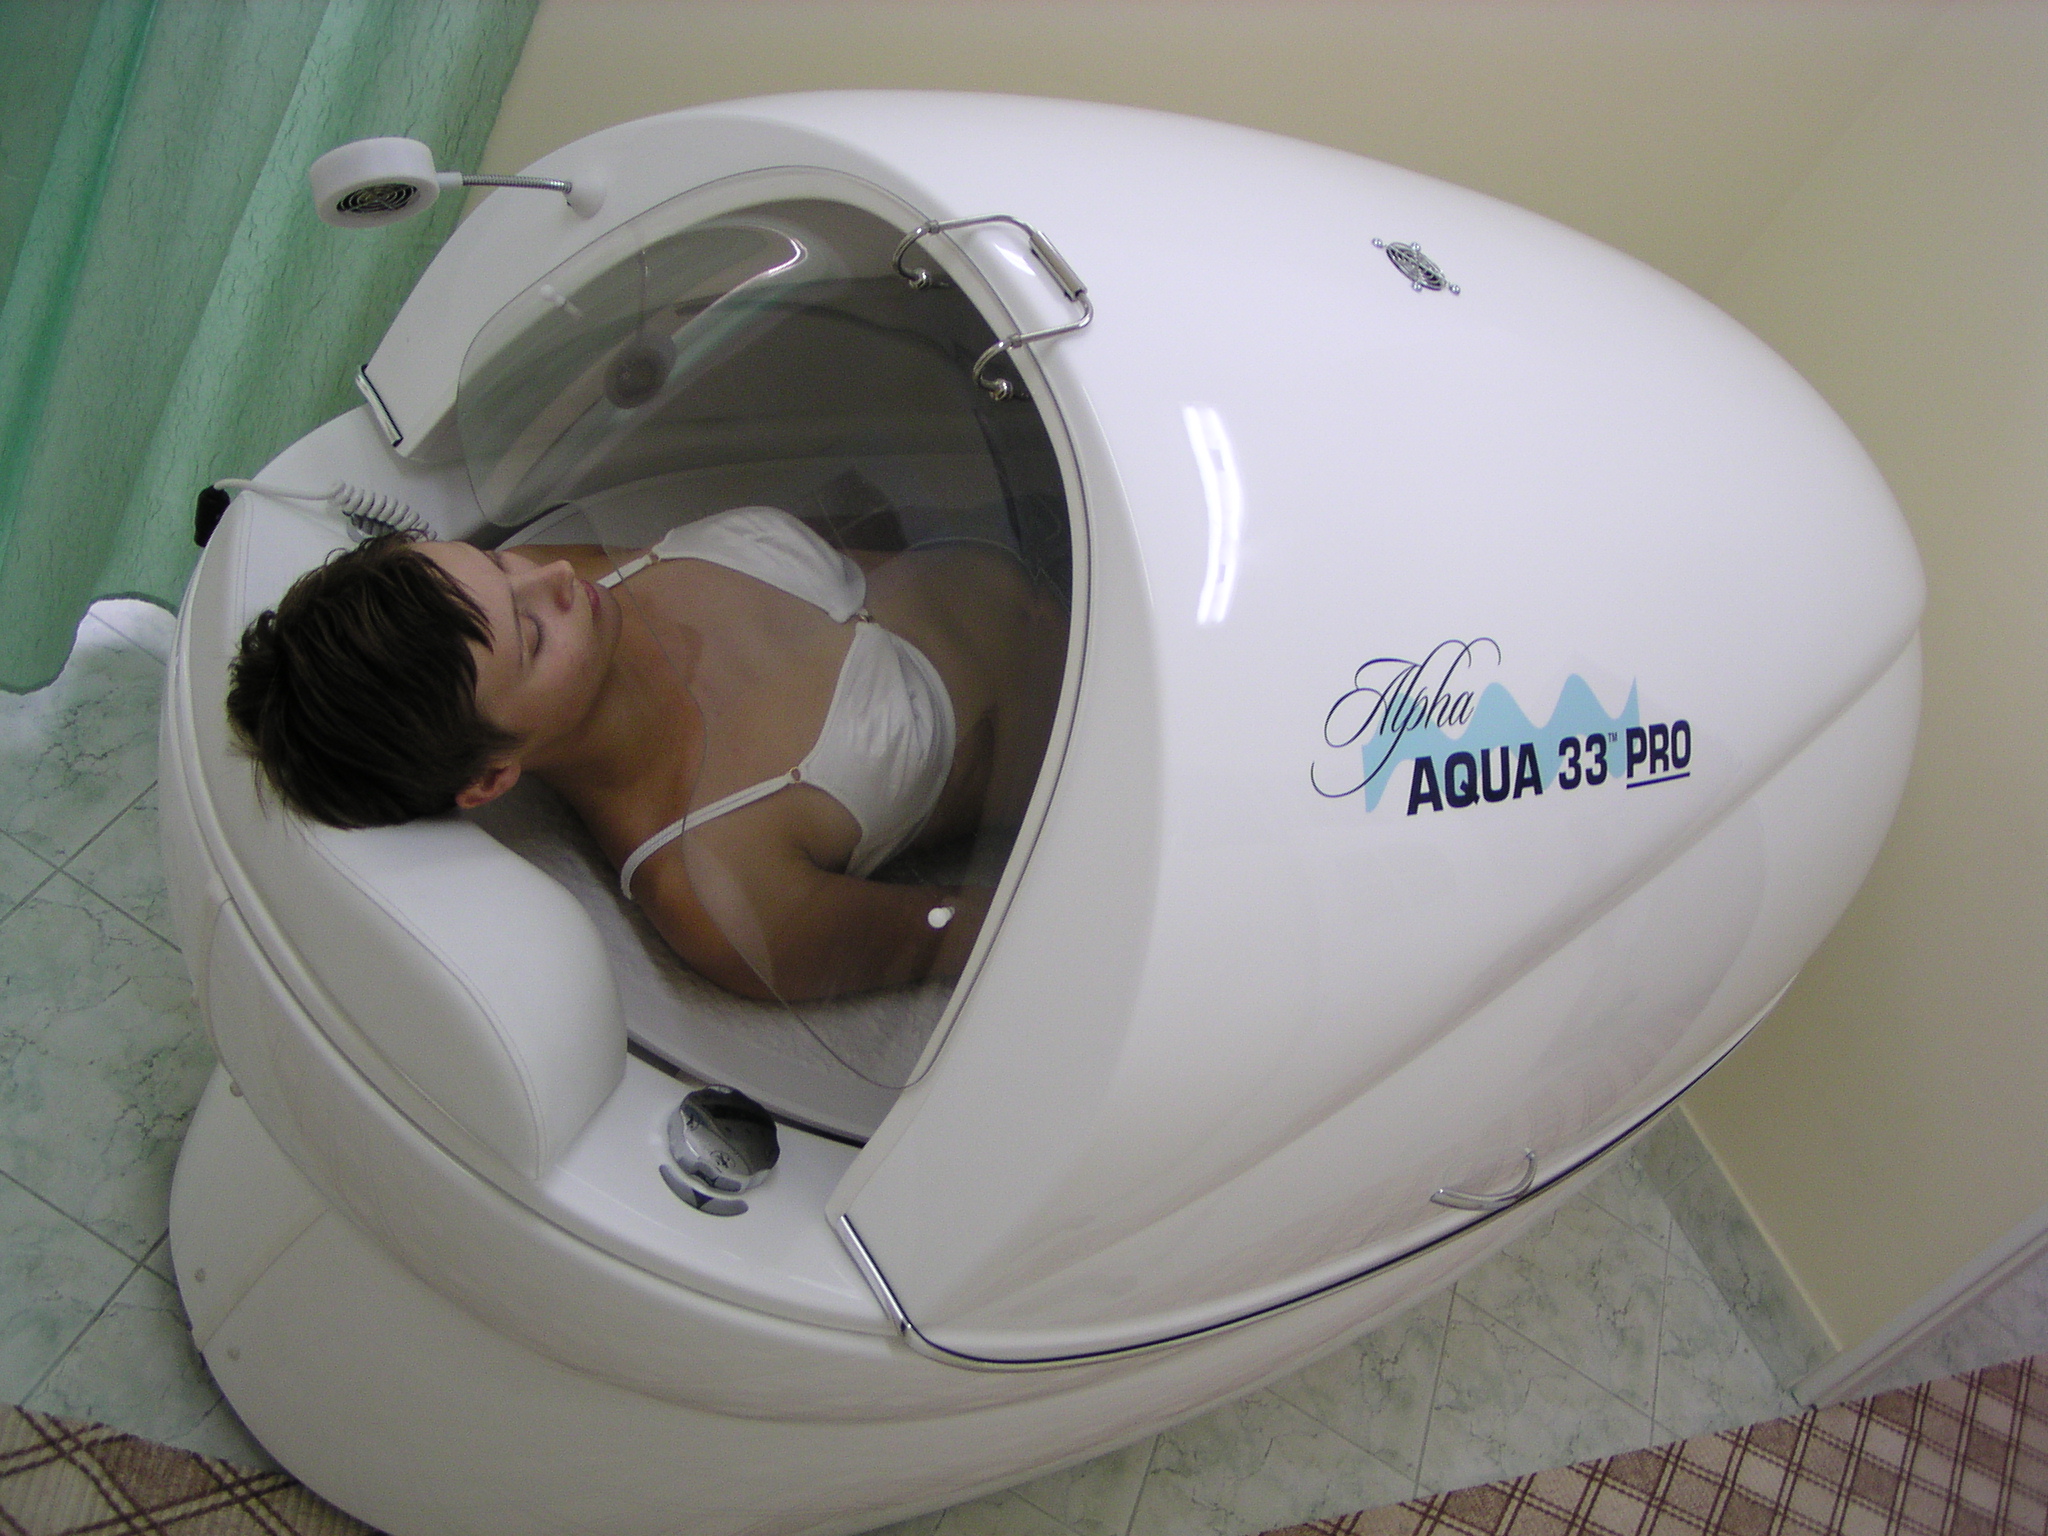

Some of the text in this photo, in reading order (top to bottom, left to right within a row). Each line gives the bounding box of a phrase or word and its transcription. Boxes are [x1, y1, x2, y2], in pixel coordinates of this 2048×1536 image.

[1310, 637, 1501, 798] Alpha
[1406, 742, 1543, 816] AQUA
[1626, 719, 1692, 779] PRO
